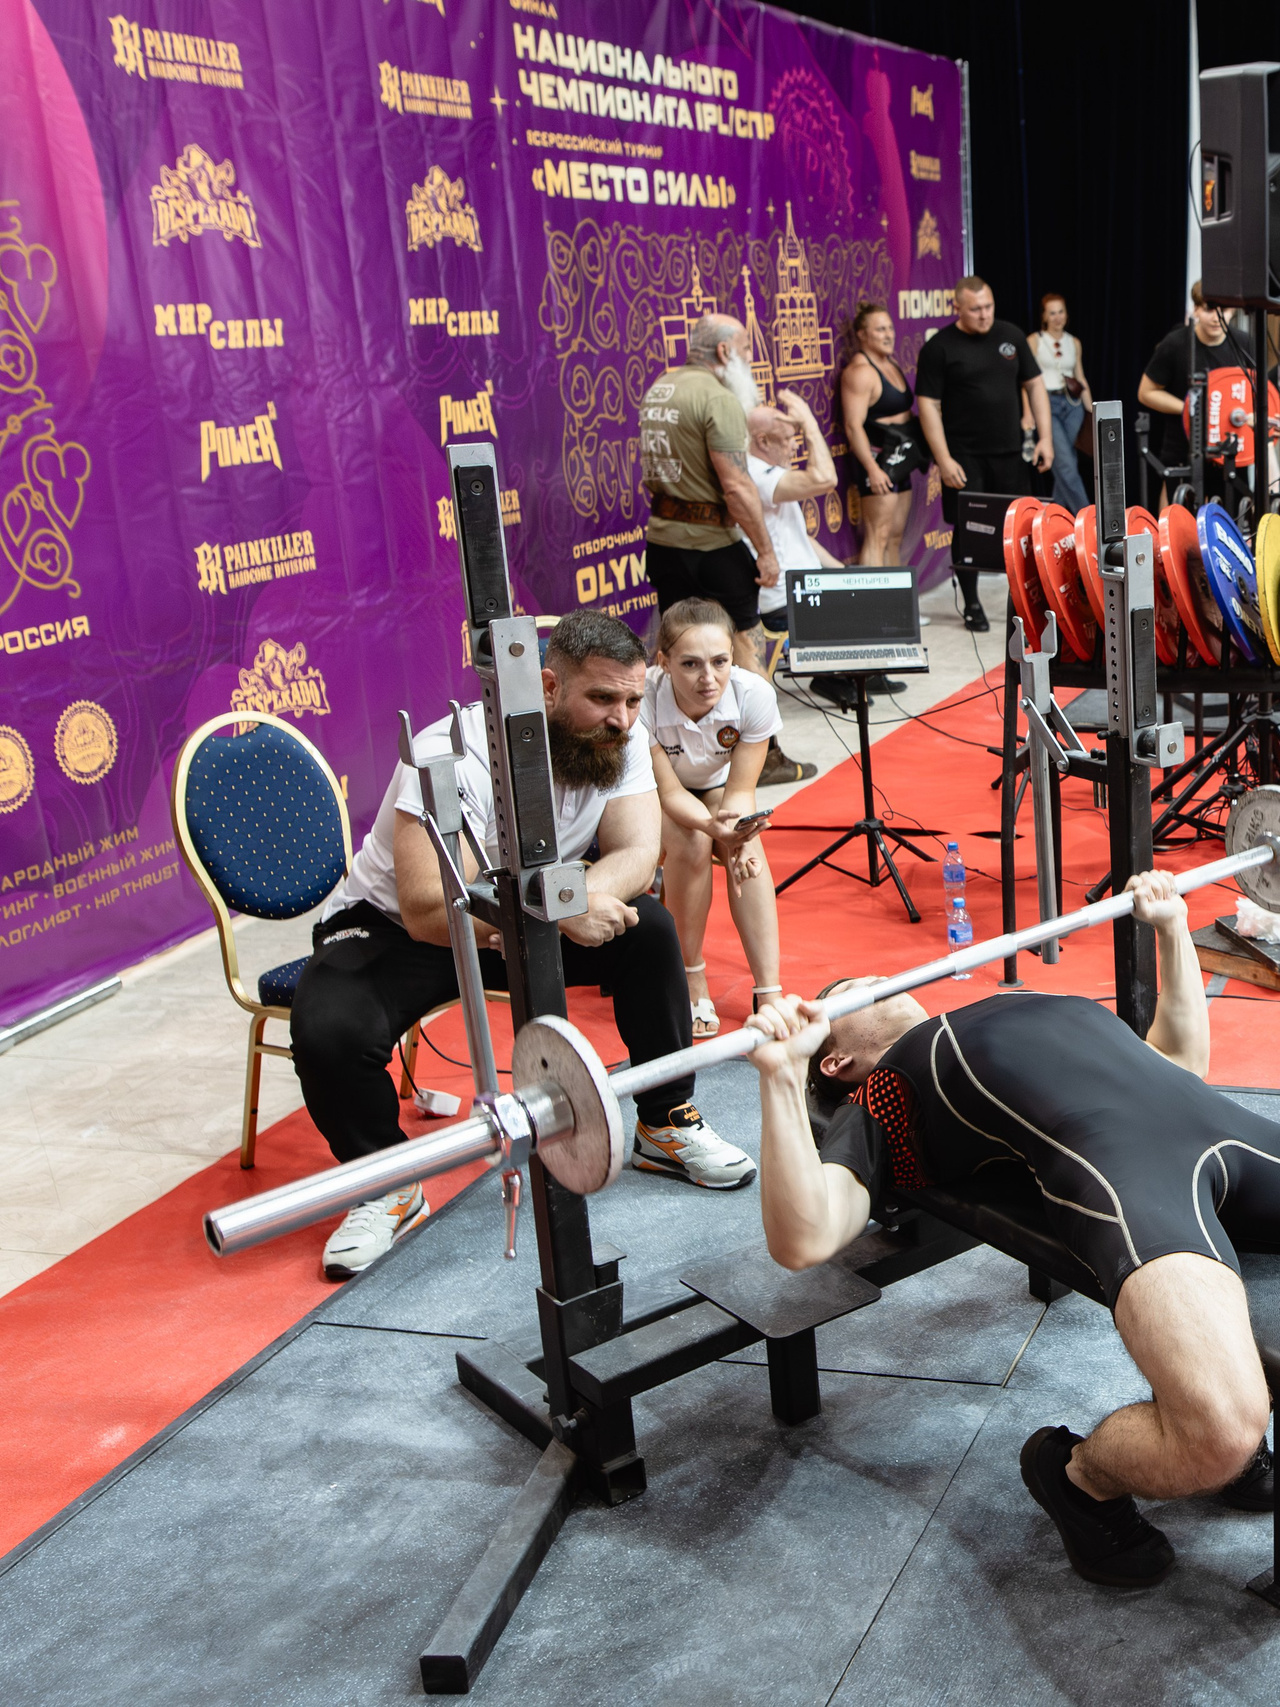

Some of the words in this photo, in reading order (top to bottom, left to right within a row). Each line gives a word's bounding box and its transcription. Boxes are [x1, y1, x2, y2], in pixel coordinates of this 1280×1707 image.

[142, 26, 243, 73] PAINKILLER
[512, 21, 740, 102] НАЦИОНАЛЬНОГО
[400, 70, 472, 105] PAINKILLER
[518, 68, 694, 131] ЧЕМПИОНАТА
[526, 129, 623, 157] ВСЕРОССИЙСКИЙ
[531, 158, 650, 204] «МЕСТО
[653, 168, 737, 209] СИЛЫ»
[157, 195, 254, 240] DESPERADO
[1209, 390, 1222, 444] ELEIKO
[200, 414, 283, 483] POWER
[223, 530, 315, 572] PAINKILLER
[573, 524, 643, 559] ОТБОРОЧНЫЙ
[228, 563, 273, 590] HARDCORE
[275, 556, 317, 581] DIVISION
[807, 577, 821, 588] 35
[807, 594, 821, 608] 11
[99, 826, 139, 853] ЖИМ
[53, 853, 136, 899] ВОЕННЫЙ
[140, 838, 176, 864] ЖИМ
[94, 887, 121, 910] HIP
[122, 861, 180, 897] THRUST
